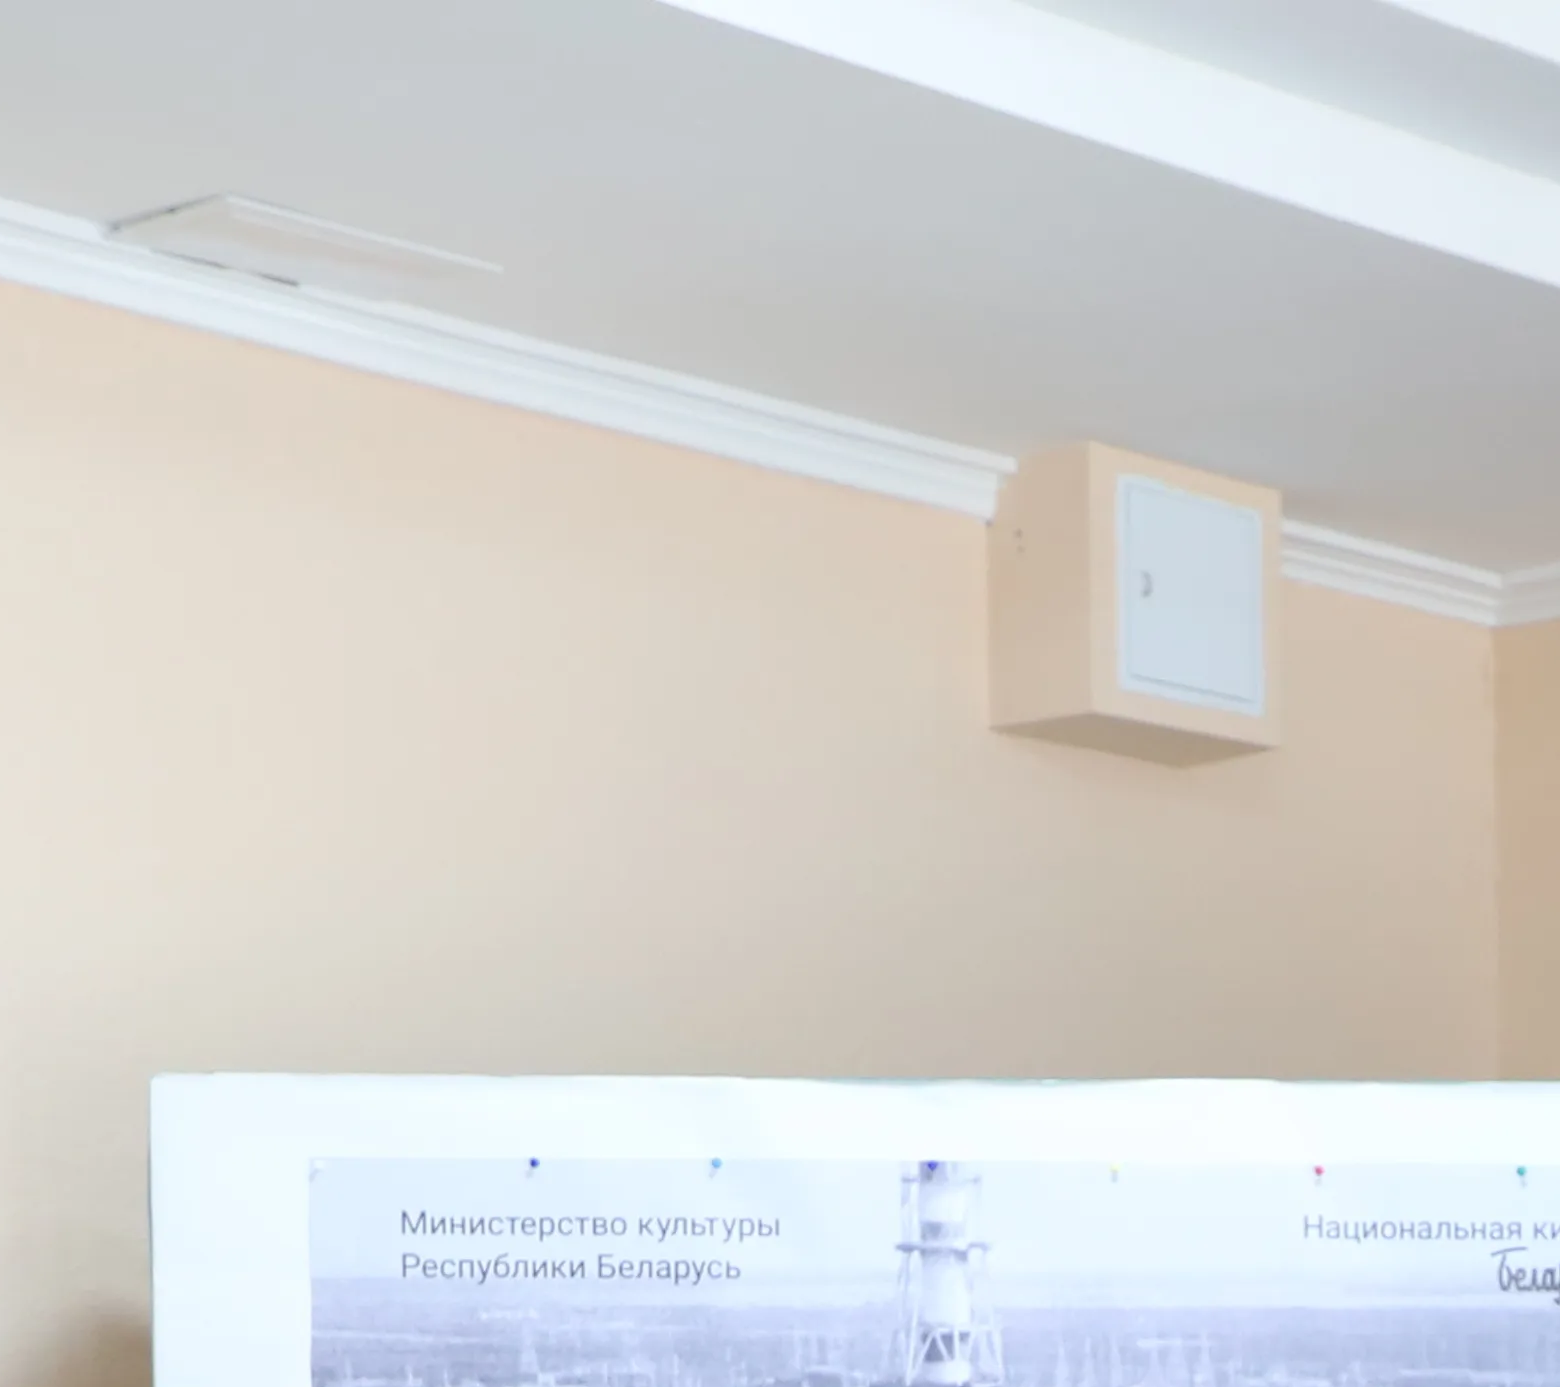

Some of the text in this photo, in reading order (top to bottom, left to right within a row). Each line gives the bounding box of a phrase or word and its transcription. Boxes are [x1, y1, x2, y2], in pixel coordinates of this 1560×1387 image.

[401, 1210, 781, 1243] Министерство культуры
[1303, 1214, 1522, 1246] Национальная
[401, 1253, 742, 1285] Республики Беларусь
